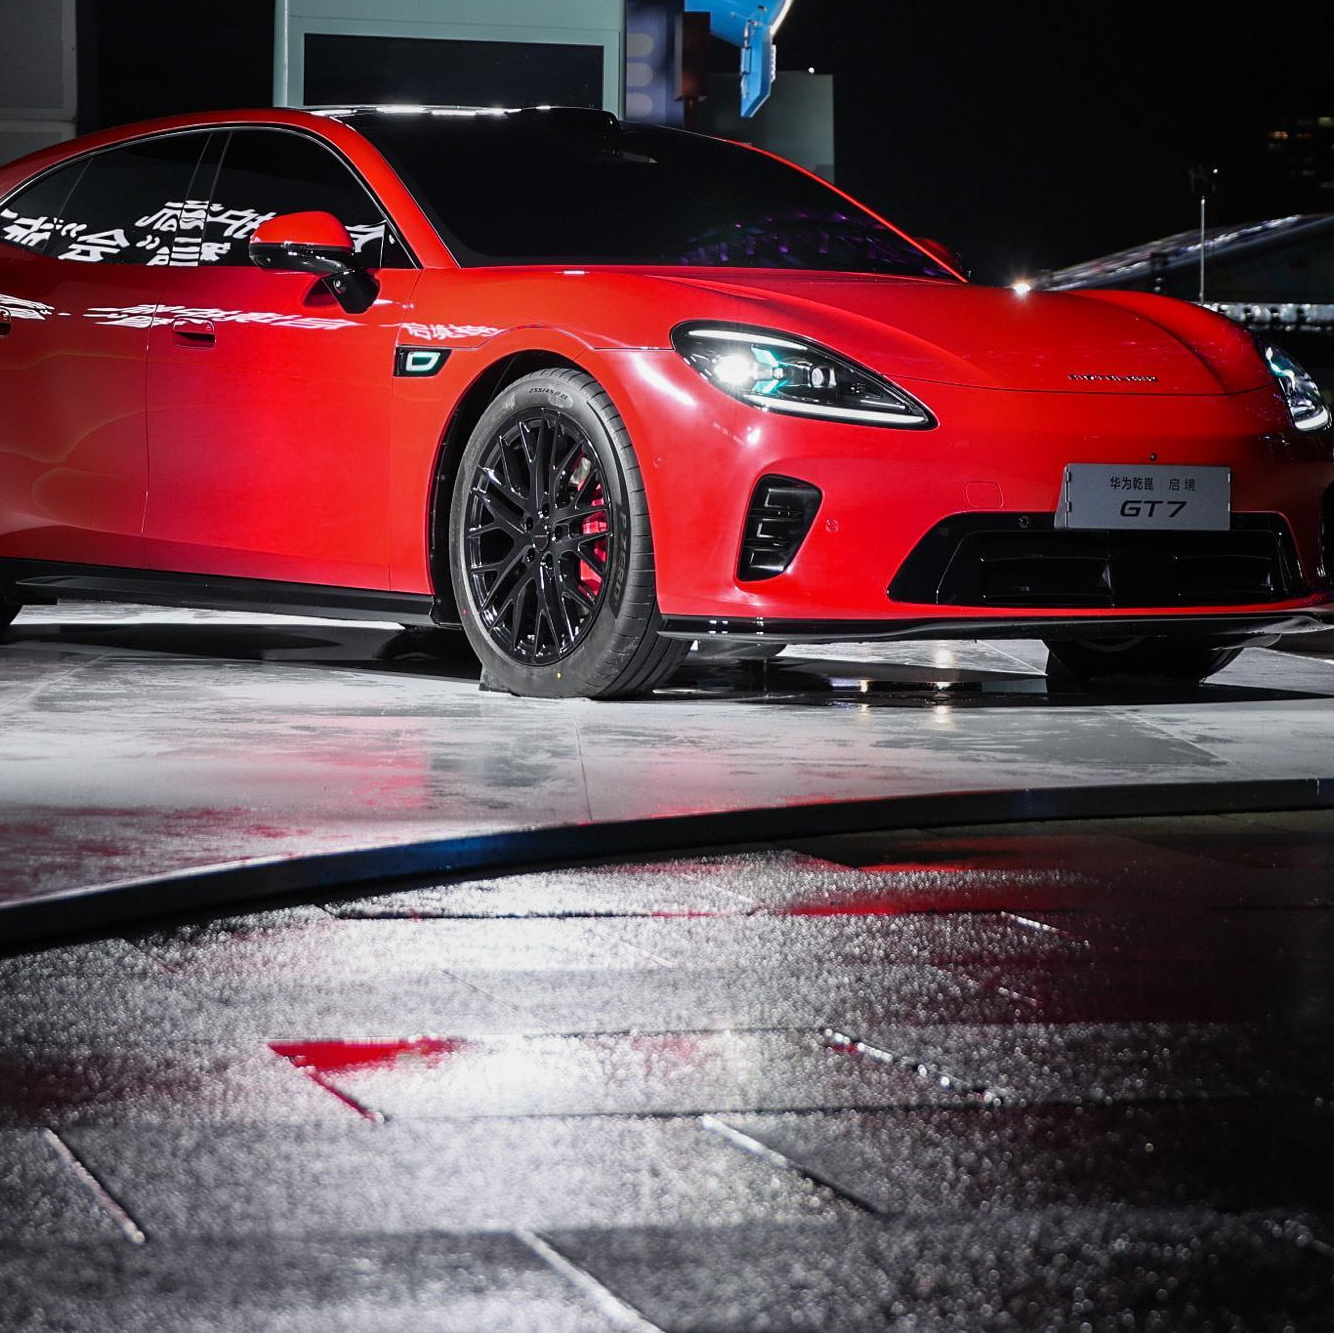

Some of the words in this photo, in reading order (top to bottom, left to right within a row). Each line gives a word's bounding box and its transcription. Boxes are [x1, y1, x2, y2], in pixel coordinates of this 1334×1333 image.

[1110, 476, 1154, 491] 华为乾崑
[1120, 500, 1187, 518] GT7
